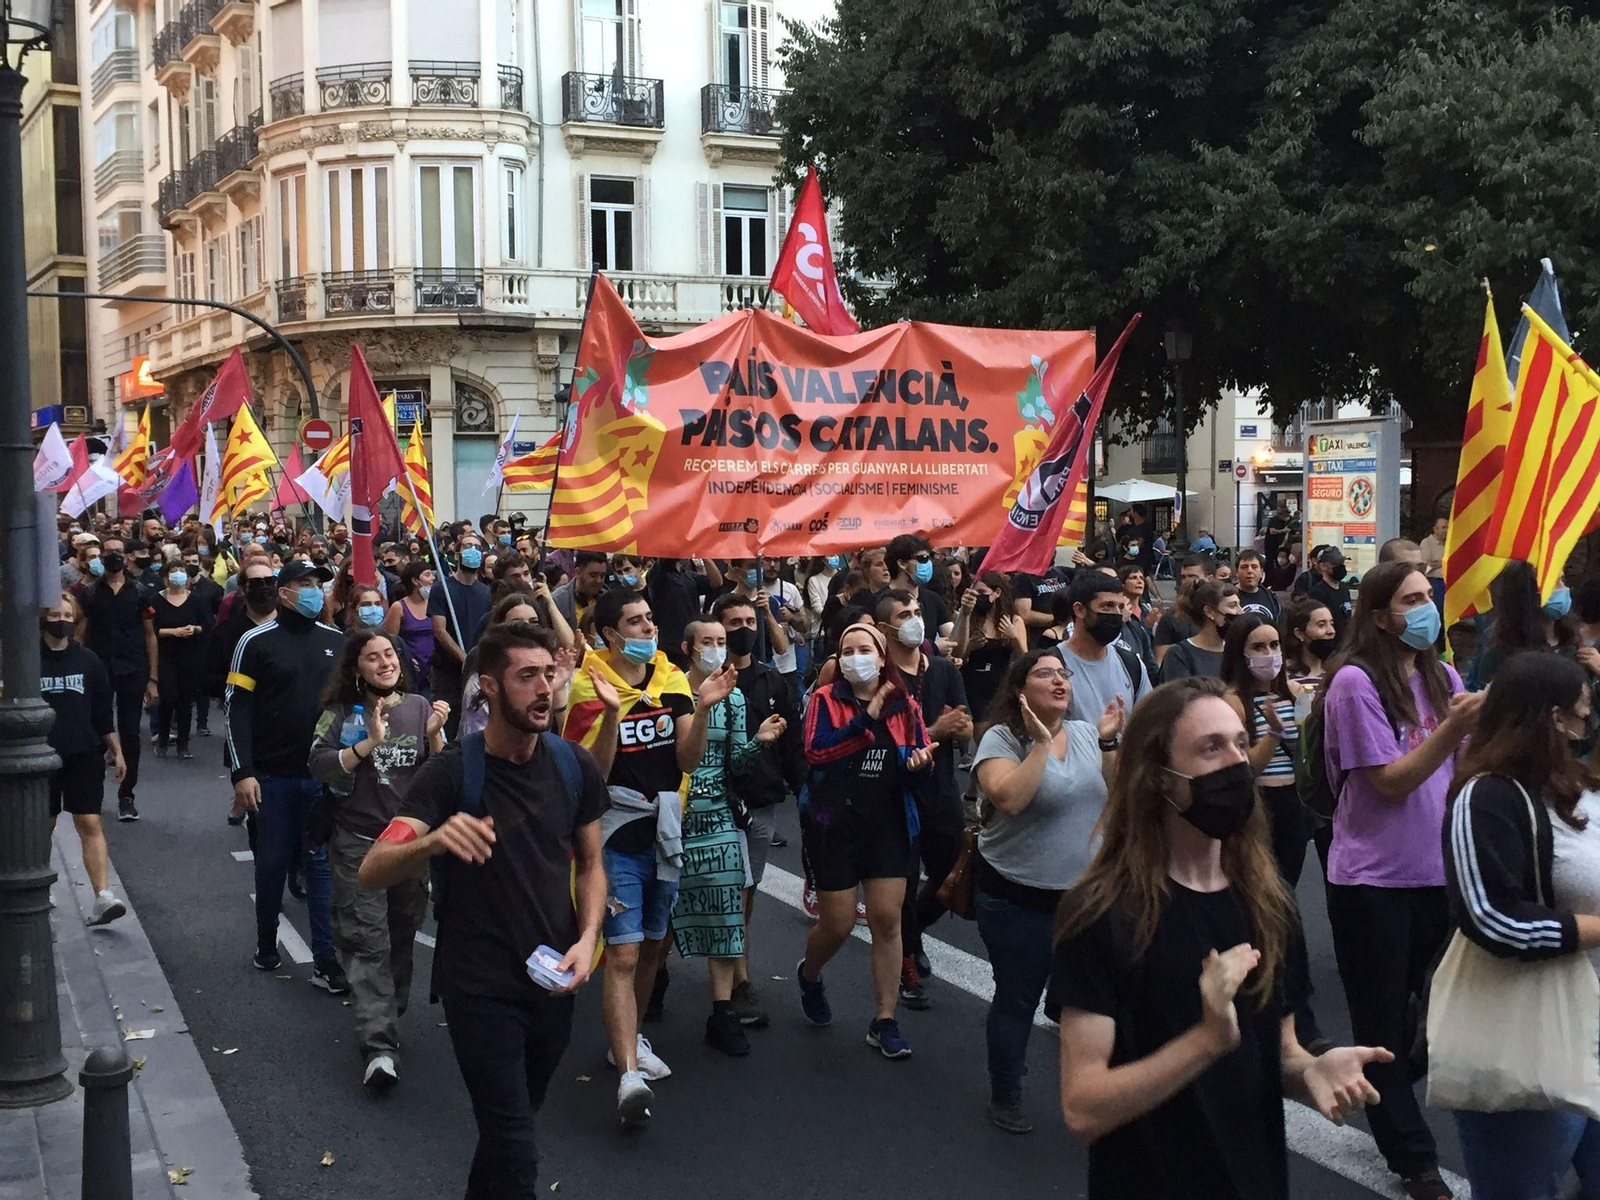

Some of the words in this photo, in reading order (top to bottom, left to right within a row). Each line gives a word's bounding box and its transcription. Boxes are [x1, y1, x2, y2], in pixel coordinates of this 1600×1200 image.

[700, 346, 778, 400] PAÍS
[780, 360, 969, 412] VALENCIÀ,
[809, 416, 999, 453] CATALANS.
[1320, 438, 1343, 452] TAXI
[761, 460, 779, 474] ELS
[828, 462, 850, 474] PER
[852, 462, 908, 475] GUANYAR
[910, 463, 924, 475] LA
[925, 463, 989, 476] LLIBERTAT!
[1327, 460, 1344, 471] TAXI
[815, 482, 884, 496] SOCIALISME
[892, 482, 959, 496] FEMINISME
[1312, 488, 1342, 498] SEGURO
